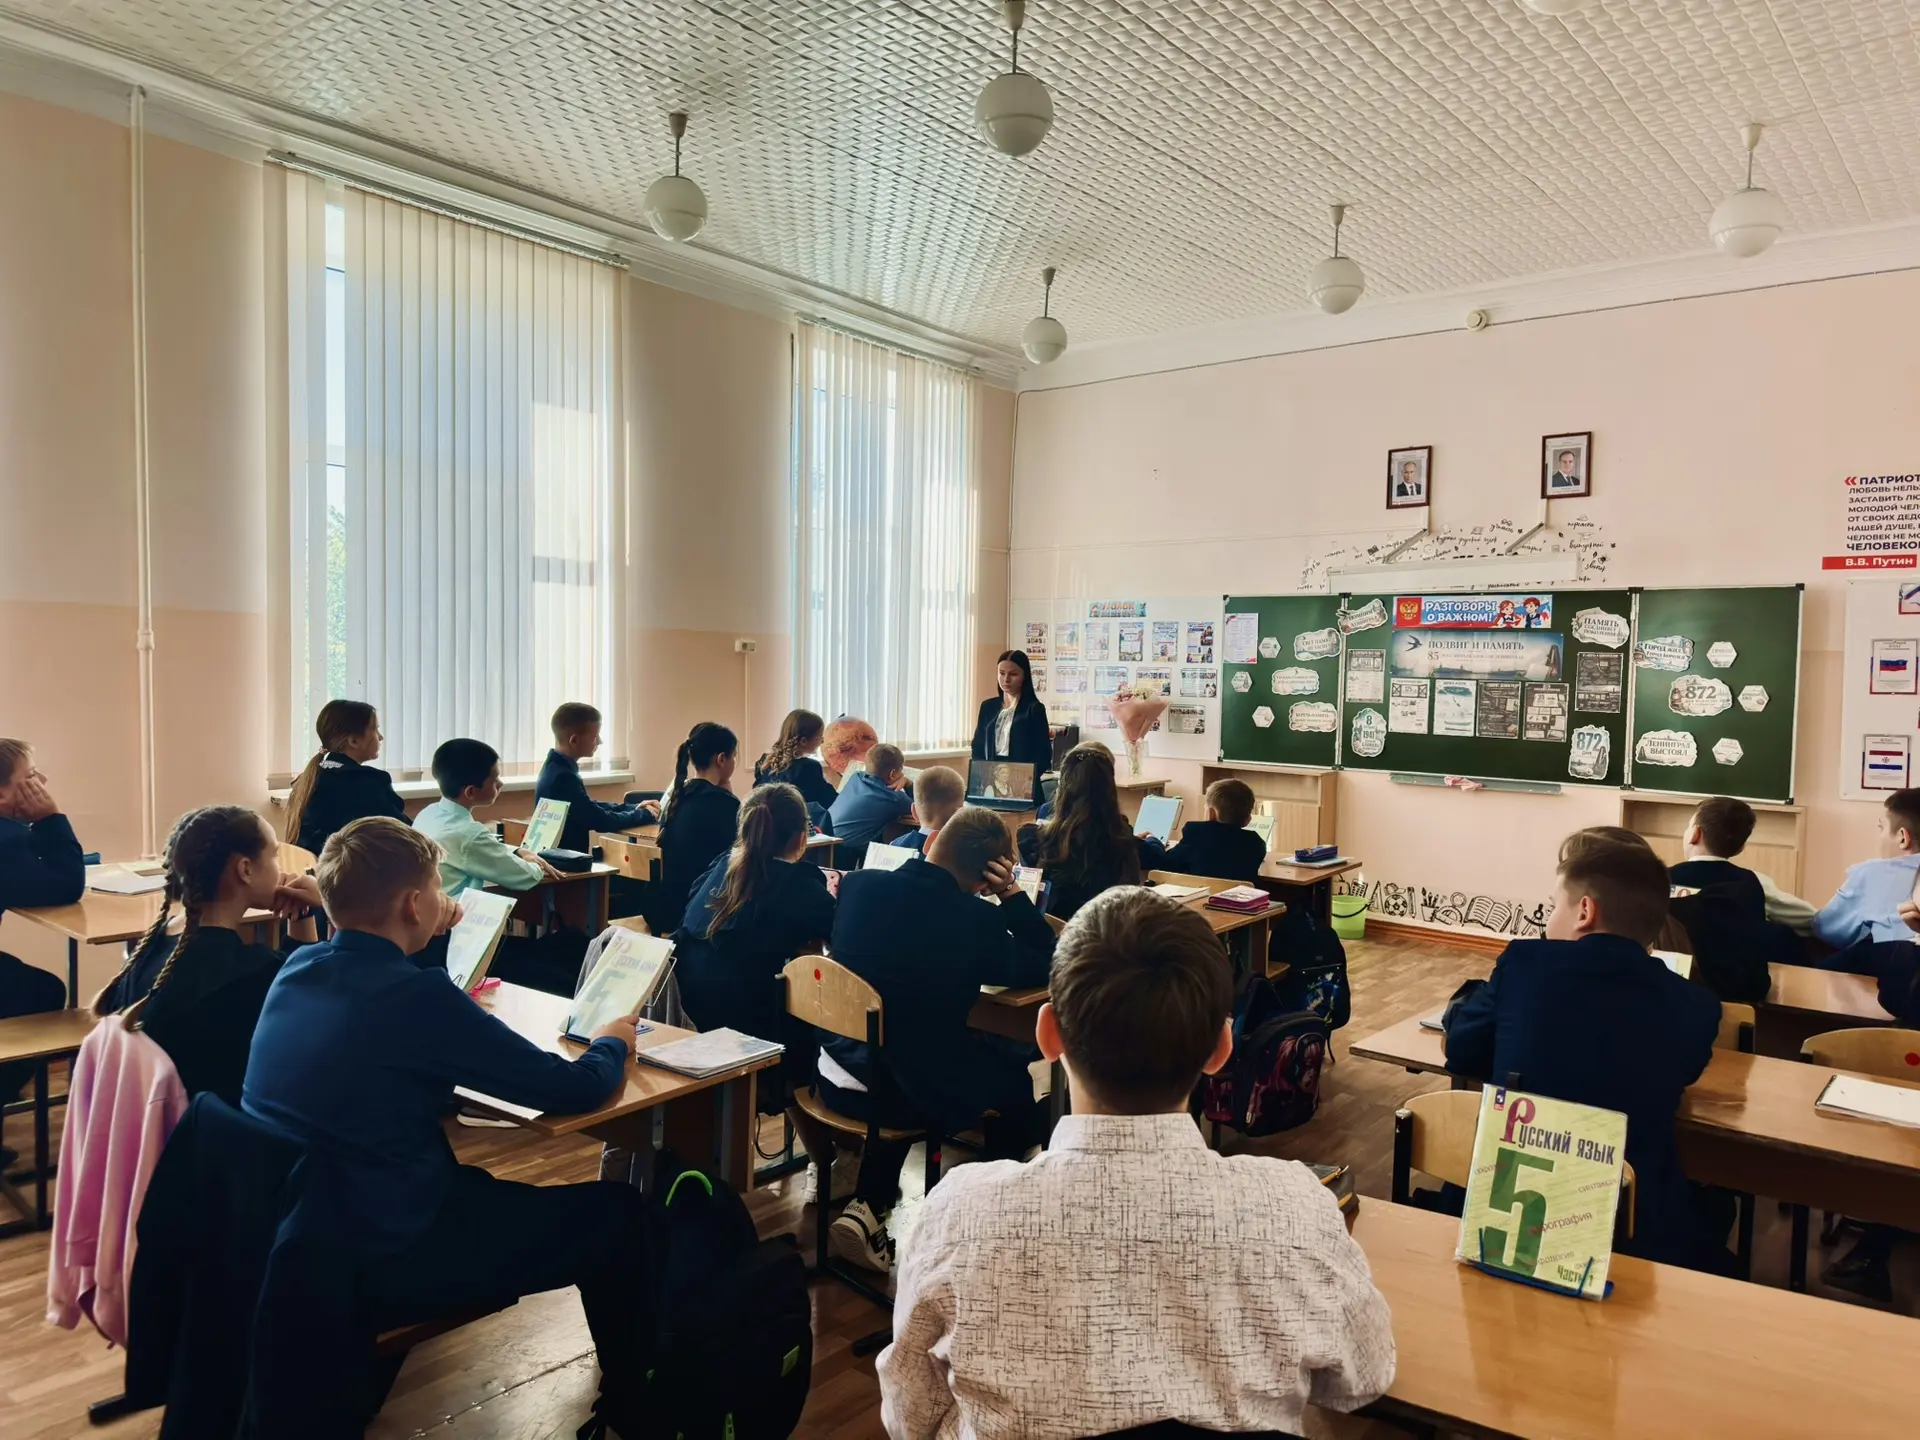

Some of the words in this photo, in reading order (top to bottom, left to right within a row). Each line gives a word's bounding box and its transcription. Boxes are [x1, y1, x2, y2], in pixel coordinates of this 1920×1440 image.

[1848, 486, 1891, 494] ЛЮБОВЬ
[1848, 495, 1903, 504] ЗАСТАВИТЬ
[1848, 504, 1898, 513] МОЛОДОЙ
[1847, 523, 1882, 531] НАШЕЙ
[1884, 523, 1916, 531] ДУШЕ,
[1846, 541, 1920, 551] ЧЕЛОВЕКО
[1845, 558, 1869, 566] В.В.
[1872, 557, 1913, 567] Путин
[1425, 600, 1497, 612] РАЗГОВОРЫ
[1427, 612, 1435, 621] О
[1437, 611, 1493, 622] ВАЖНОМ!
[1584, 618, 1619, 627] ПАМЯТЬ
[1428, 640, 1470, 649] ПОДВИГ
[1472, 641, 1480, 649] И
[1483, 641, 1525, 650] ПАМЯТЬ
[1427, 651, 1440, 660] 85
[1685, 685, 1717, 699] 872
[1366, 715, 1372, 726] 8
[1576, 731, 1602, 751] 872
[1645, 740, 1691, 749] ЛЕНИНГРАД
[1650, 748, 1688, 756] ВЫСТОЯЛ
[1482, 1146, 1555, 1277] 5
[1588, 1274, 1594, 1287] 1
